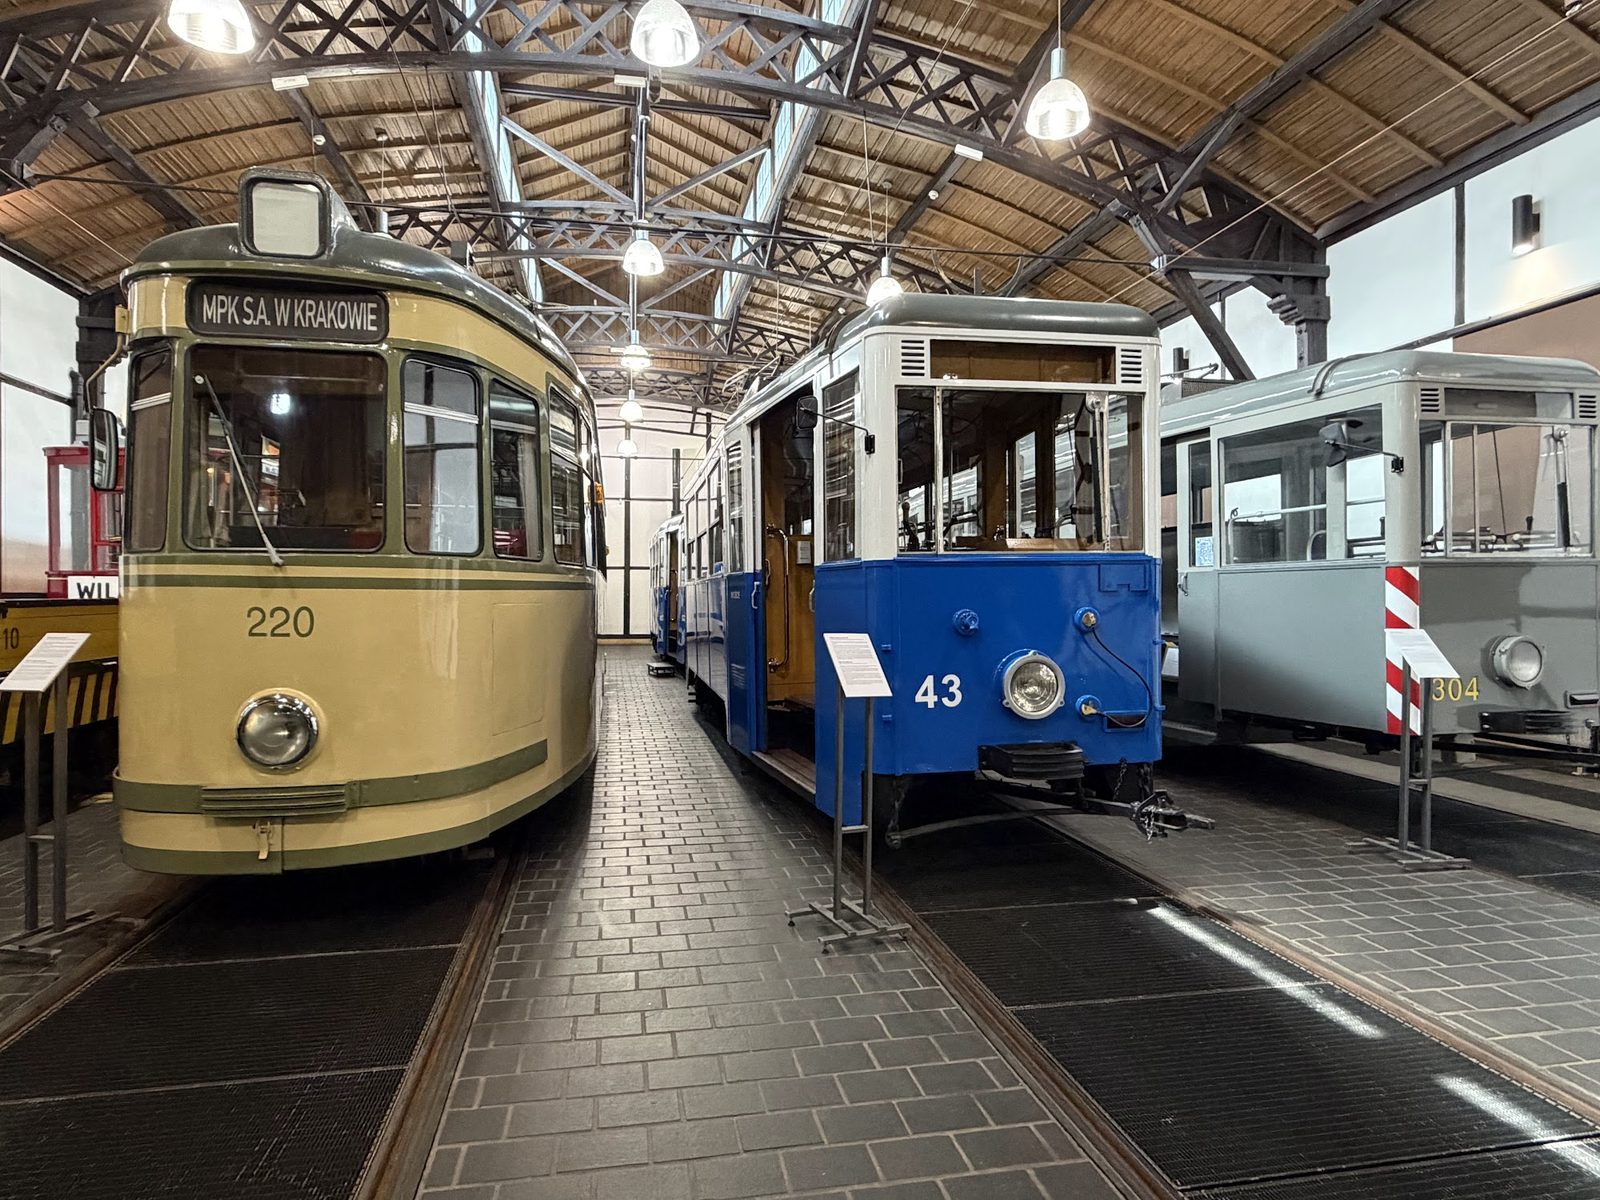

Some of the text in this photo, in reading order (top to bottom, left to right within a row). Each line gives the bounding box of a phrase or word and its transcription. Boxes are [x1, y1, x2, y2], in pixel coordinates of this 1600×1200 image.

[203, 294, 378, 331] MPK S.A. W KRAKOWIE
[247, 606, 314, 638] 220
[3, 627, 19, 650] 10
[915, 673, 963, 709] 43
[1432, 677, 1479, 702] 304
